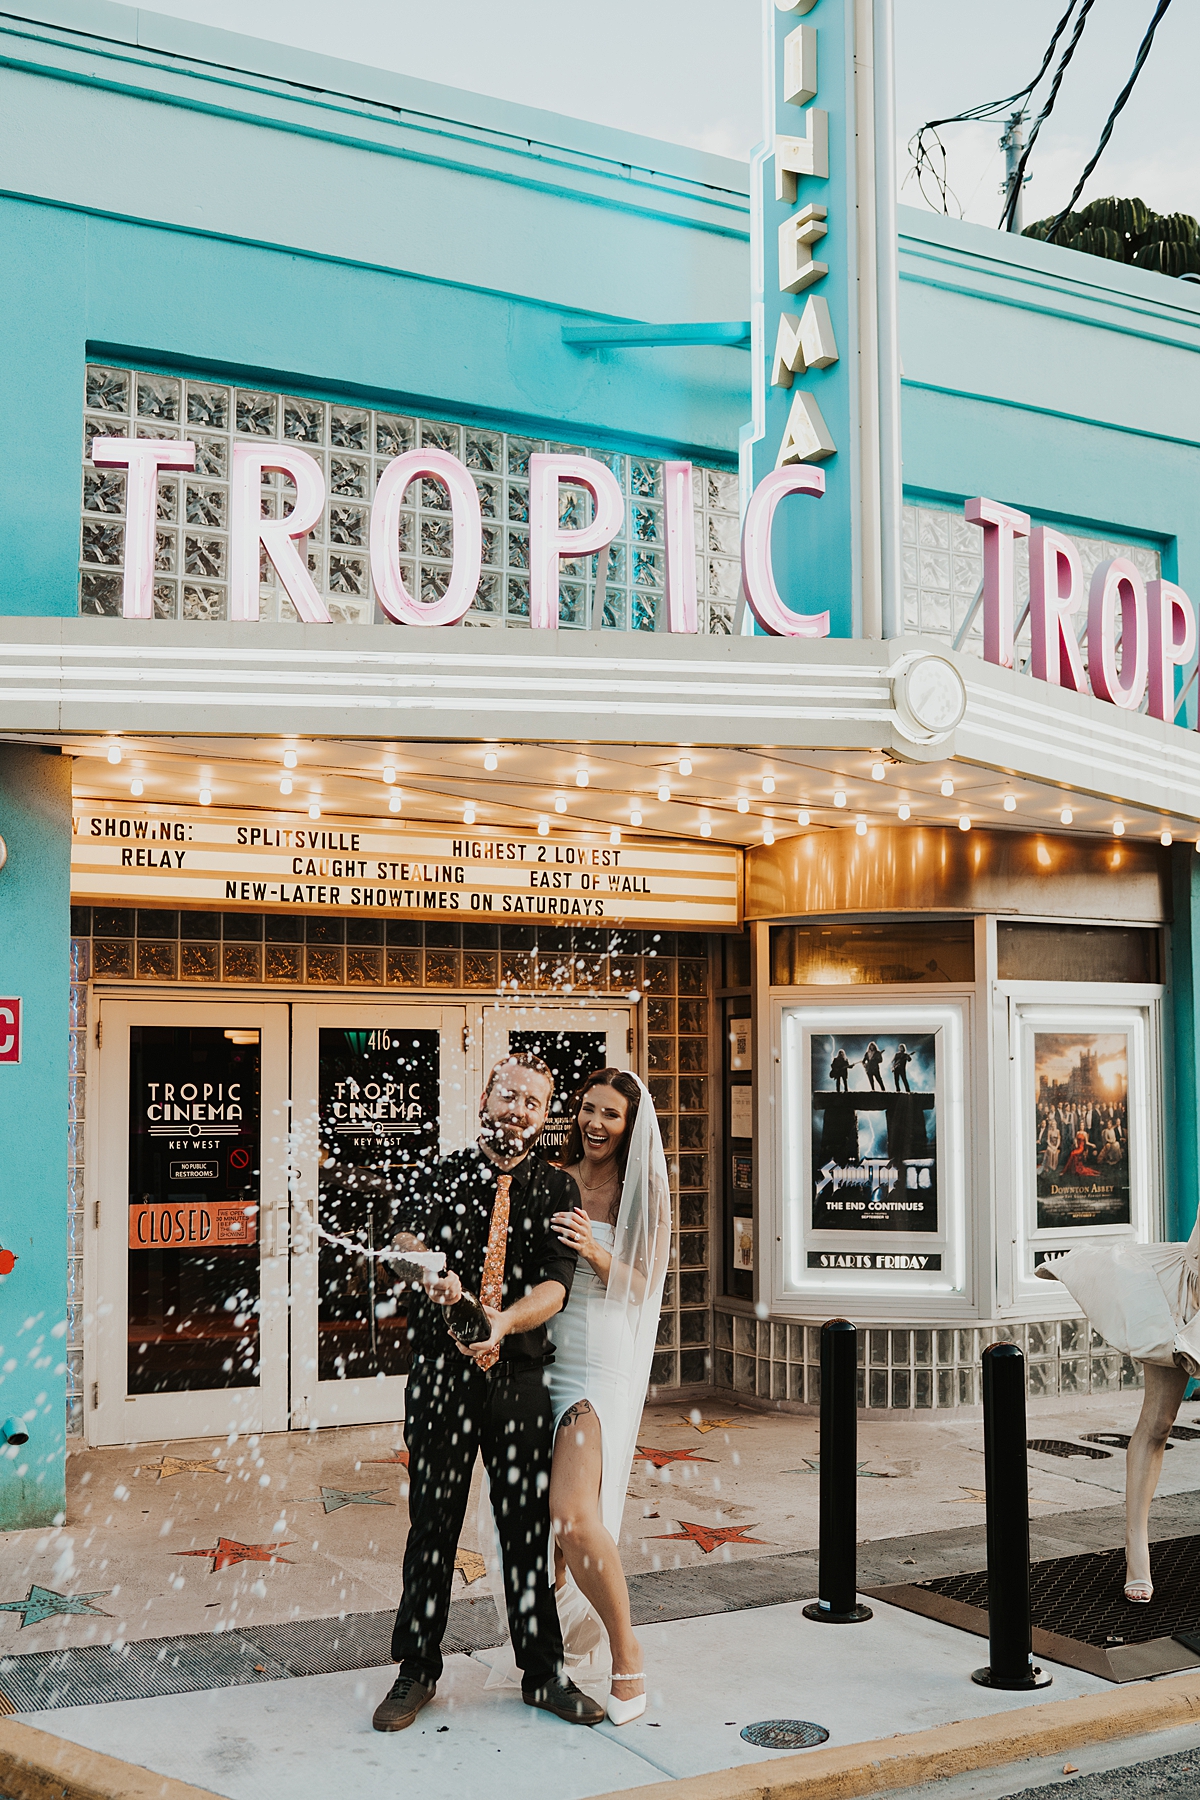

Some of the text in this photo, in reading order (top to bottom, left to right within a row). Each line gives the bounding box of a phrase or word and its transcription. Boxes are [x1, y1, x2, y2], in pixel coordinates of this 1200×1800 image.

[771, 0, 839, 470] INEMA
[91, 436, 831, 638] TROPIC
[964, 496, 1200, 733] TROP
[237, 827, 360, 851] SPLITSVILLE
[452, 840, 527, 861] HIGHEST
[537, 846, 547, 862] 2
[555, 846, 621, 866] LOWEST
[122, 848, 651, 893] RELAY CAUGHT STEALING EAST OF WALL
[225, 881, 604, 916] NEW-LATER SHOWTIMES ON SATURDAYS
[367, 1029, 391, 1050] 416
[147, 1083, 241, 1101] TROPIC
[334, 1083, 420, 1100] TROPIC
[147, 1104, 243, 1121] CINEMA
[333, 1102, 422, 1119] CINEMA
[169, 1140, 220, 1150] KEY WEST
[353, 1137, 372, 1146] KEY
[826, 1202, 924, 1211] THE END CONTINUES
[137, 1210, 211, 1244] CLOSED
[820, 1254, 929, 1269] STARTS FRIDAY
